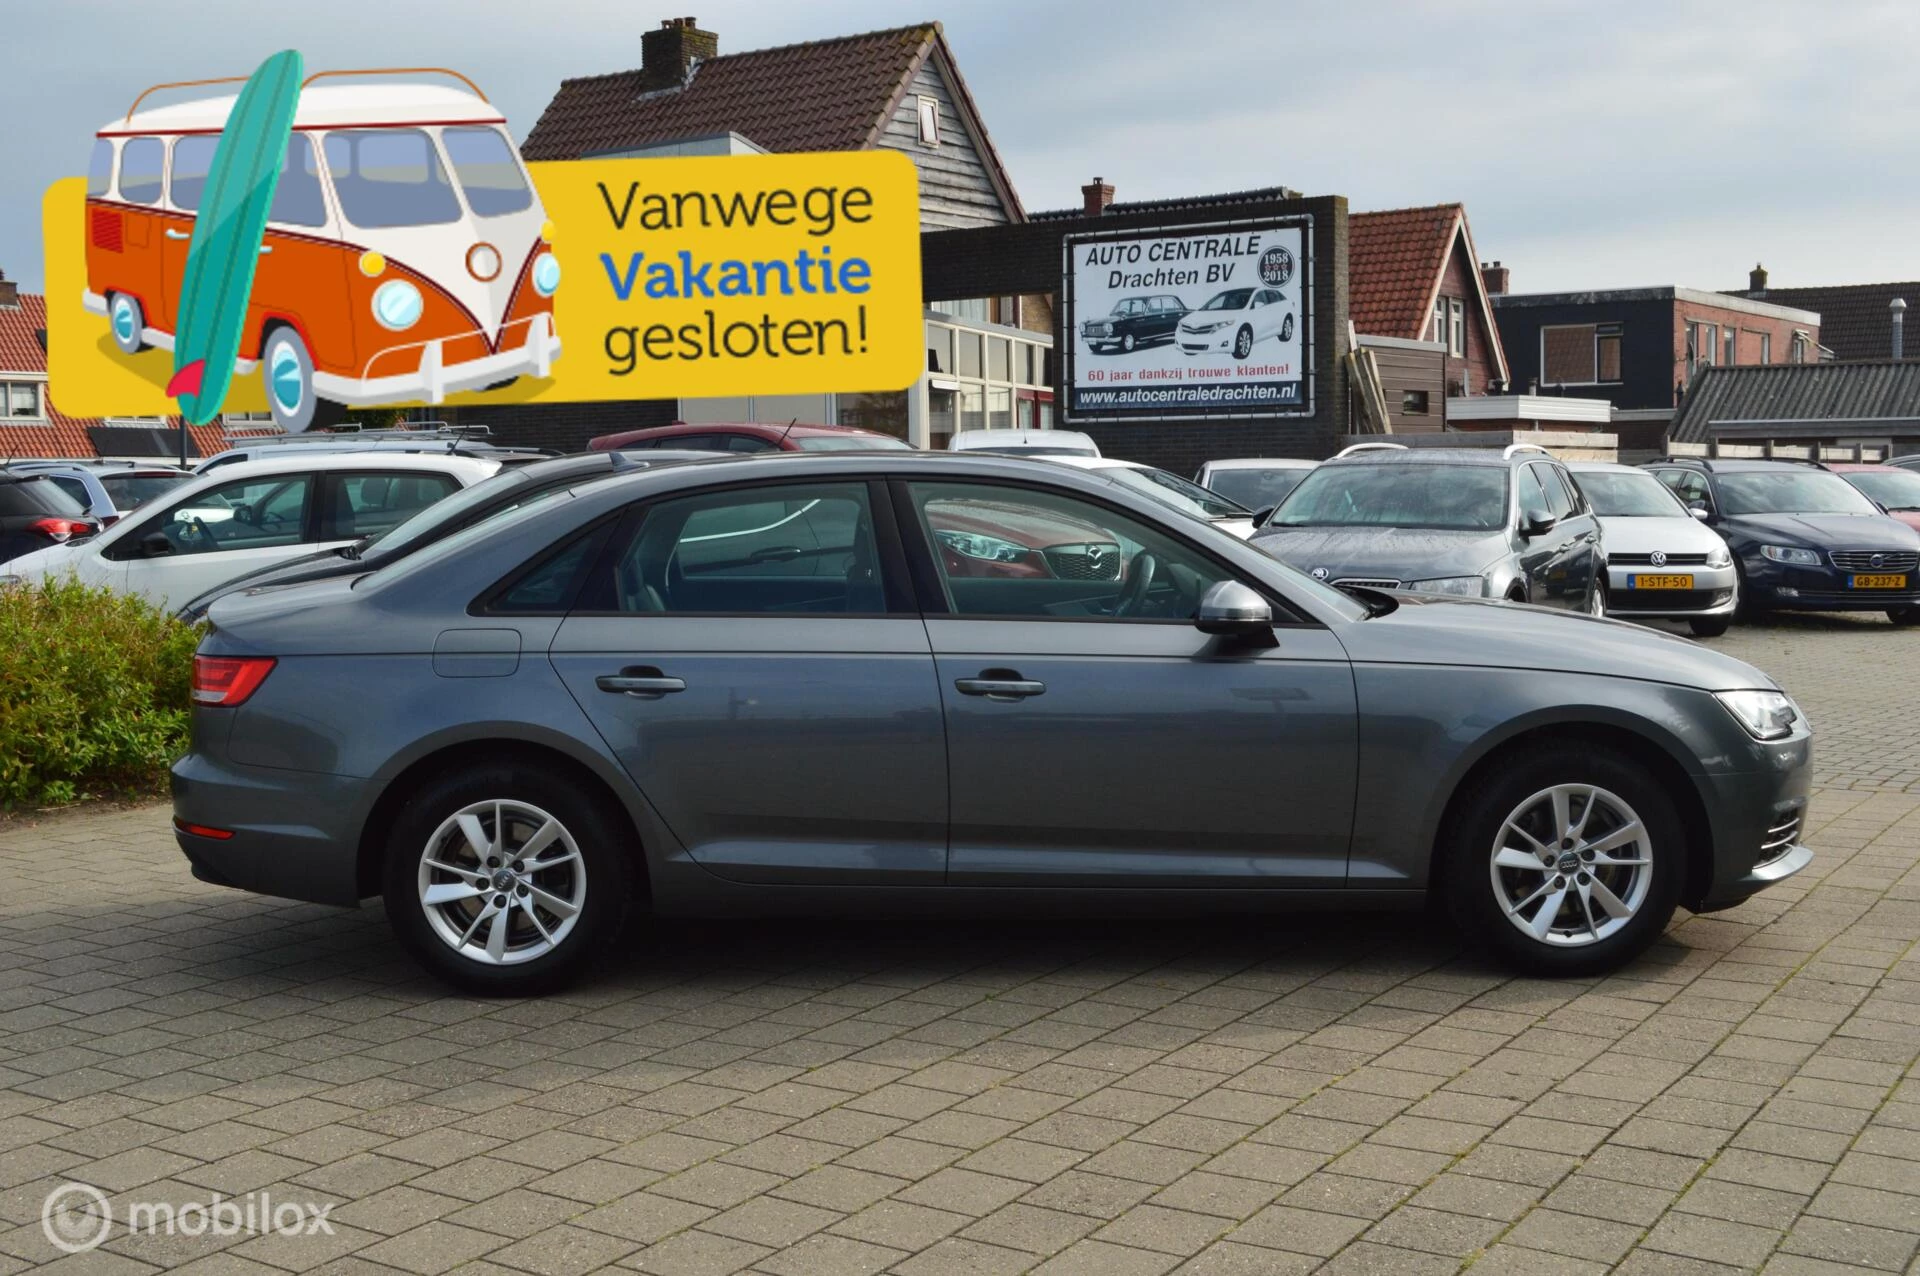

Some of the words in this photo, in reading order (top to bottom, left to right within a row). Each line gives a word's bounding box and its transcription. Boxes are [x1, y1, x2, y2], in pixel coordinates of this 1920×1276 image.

[1085, 244, 1141, 266] AUTO
[1148, 235, 1261, 262] CENTRALE
[1264, 252, 1289, 265] 1958
[1108, 269, 1198, 289] Drachten
[1206, 262, 1236, 283] BV
[1263, 269, 1289, 282] 2018
[1088, 369, 1104, 381] 60
[1110, 368, 1133, 382] jaar
[1138, 366, 1183, 381] dankzij
[1188, 364, 1231, 378] trouwe
[1236, 363, 1289, 377] klanten!
[1080, 383, 1296, 404] www.autocentraledrachten.nl
[1640, 577, 1687, 587] 1-STF-50
[1856, 576, 1901, 586] GB-237-Z
